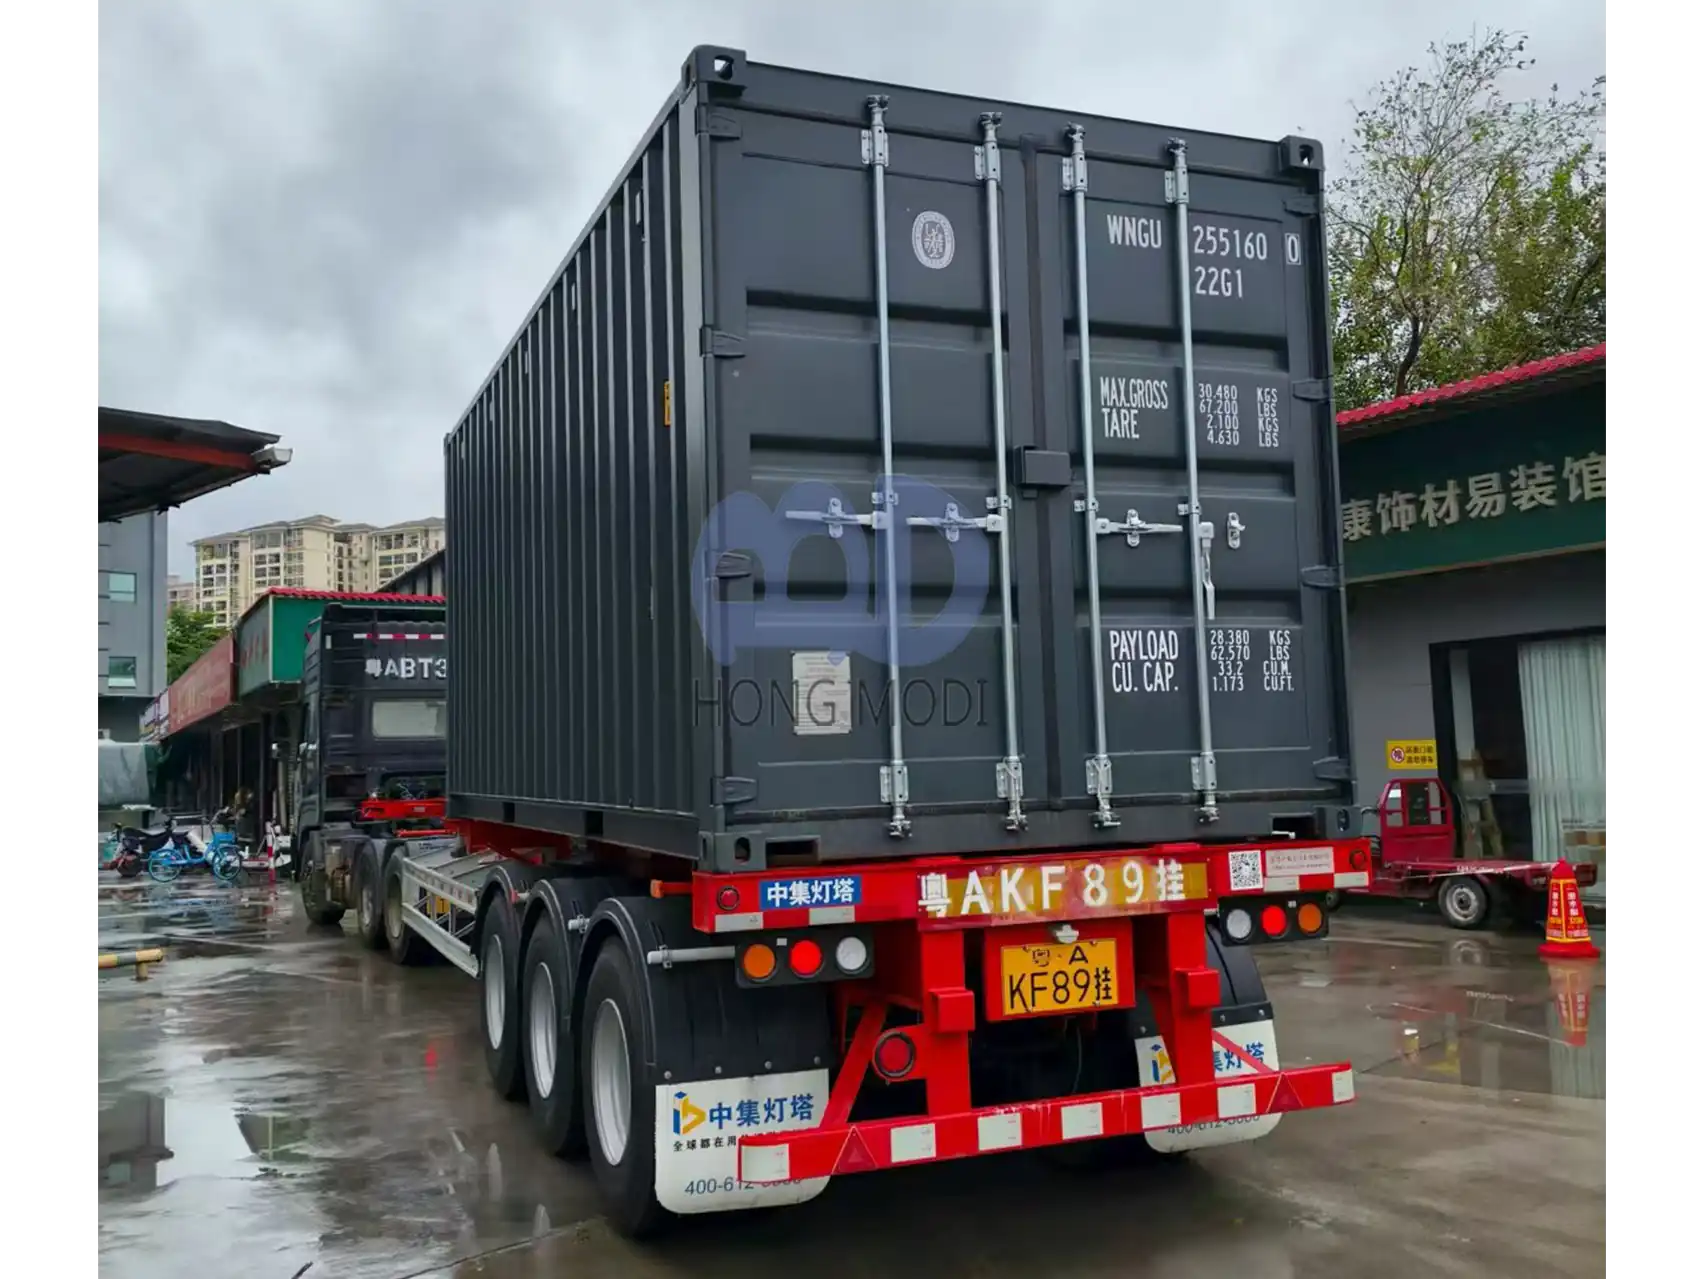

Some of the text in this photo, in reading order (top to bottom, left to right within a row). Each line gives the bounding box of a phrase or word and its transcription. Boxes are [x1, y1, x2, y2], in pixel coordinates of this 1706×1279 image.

[1107, 214, 1162, 248] WNGU
[1193, 225, 1267, 260] 255160
[1194, 266, 1243, 298] 22G1
[1198, 383, 1238, 400] 30.480
[1257, 386, 1277, 403] KGS
[1199, 398, 1277, 418] 67.200 LBS
[1101, 408, 1279, 438] TARE 2.100 KGS
[1207, 429, 1279, 447] 4.630 LBS
[1109, 629, 1291, 660] PAYLOAD 28.380 KGS
[1211, 645, 1290, 661] 62.570 LBS
[1112, 662, 1138, 692] CU.
[1143, 661, 1179, 692] CAP.
[1218, 660, 1244, 676] 33.2
[1213, 675, 1244, 692] 1.173
[767, 878, 855, 907] 中集灯塔
[1009, 967, 1112, 1013] KF89挂
[708, 1093, 814, 1130] 中集灯塔
